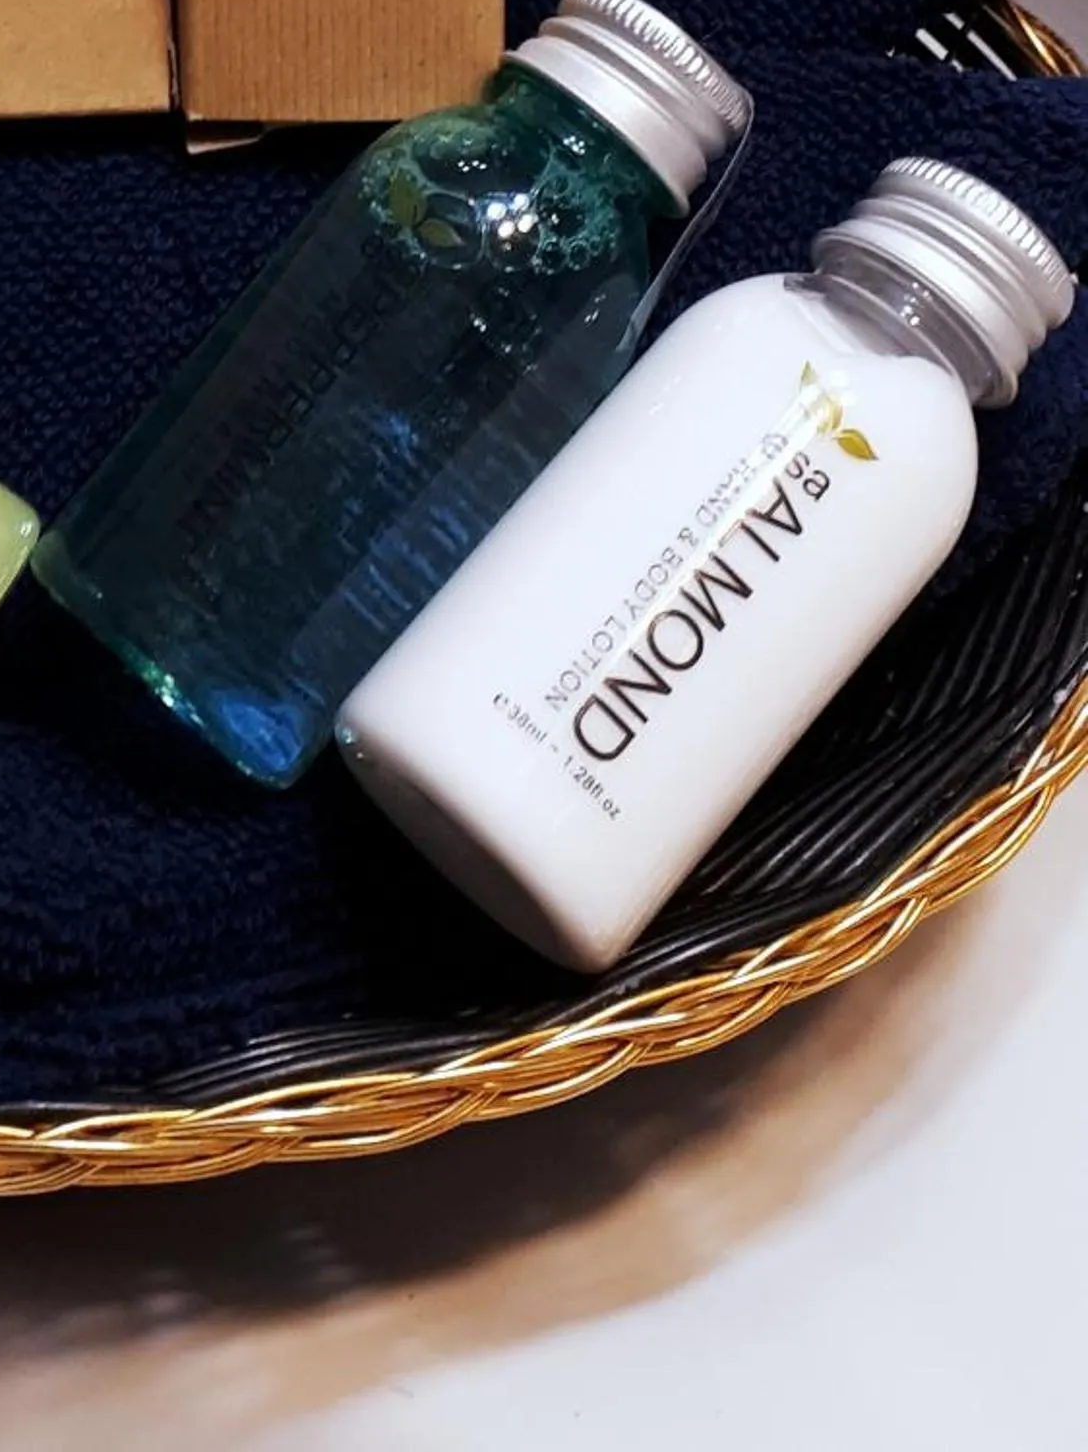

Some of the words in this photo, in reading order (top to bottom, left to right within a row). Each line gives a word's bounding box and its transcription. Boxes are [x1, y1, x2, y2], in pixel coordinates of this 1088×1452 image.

[573, 476, 803, 762] ALMOND
[626, 547, 684, 619] BODY
[544, 614, 627, 712] LOTION
